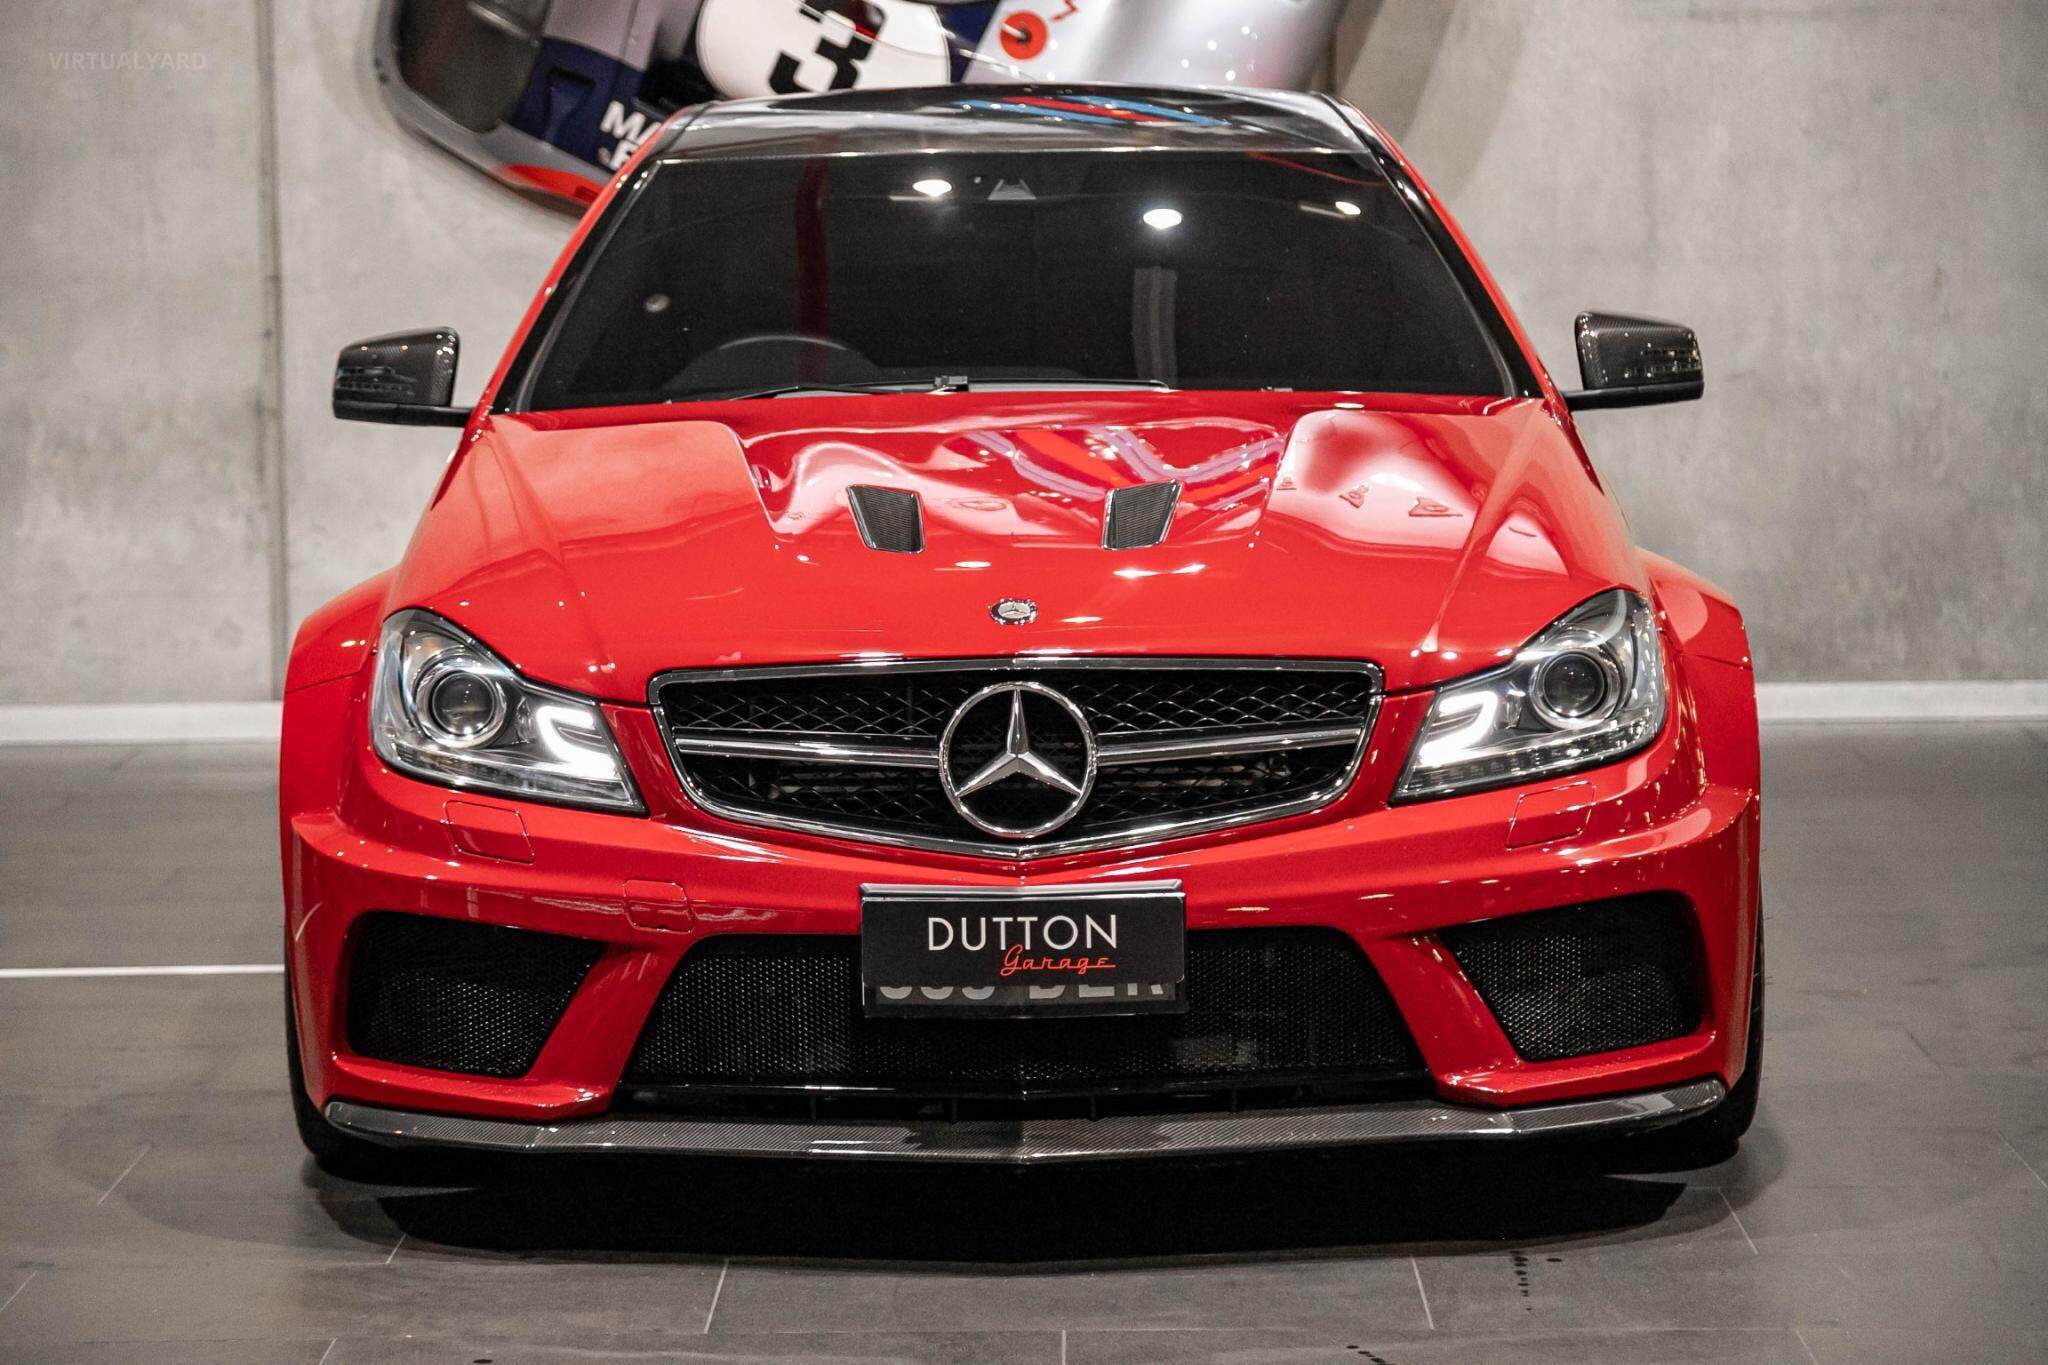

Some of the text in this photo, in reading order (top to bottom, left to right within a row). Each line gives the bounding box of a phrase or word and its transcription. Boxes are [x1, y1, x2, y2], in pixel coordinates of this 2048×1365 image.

[769, 0, 885, 94] 3
[928, 914, 1118, 951] DUTTON
[1000, 944, 1116, 977] Garage
